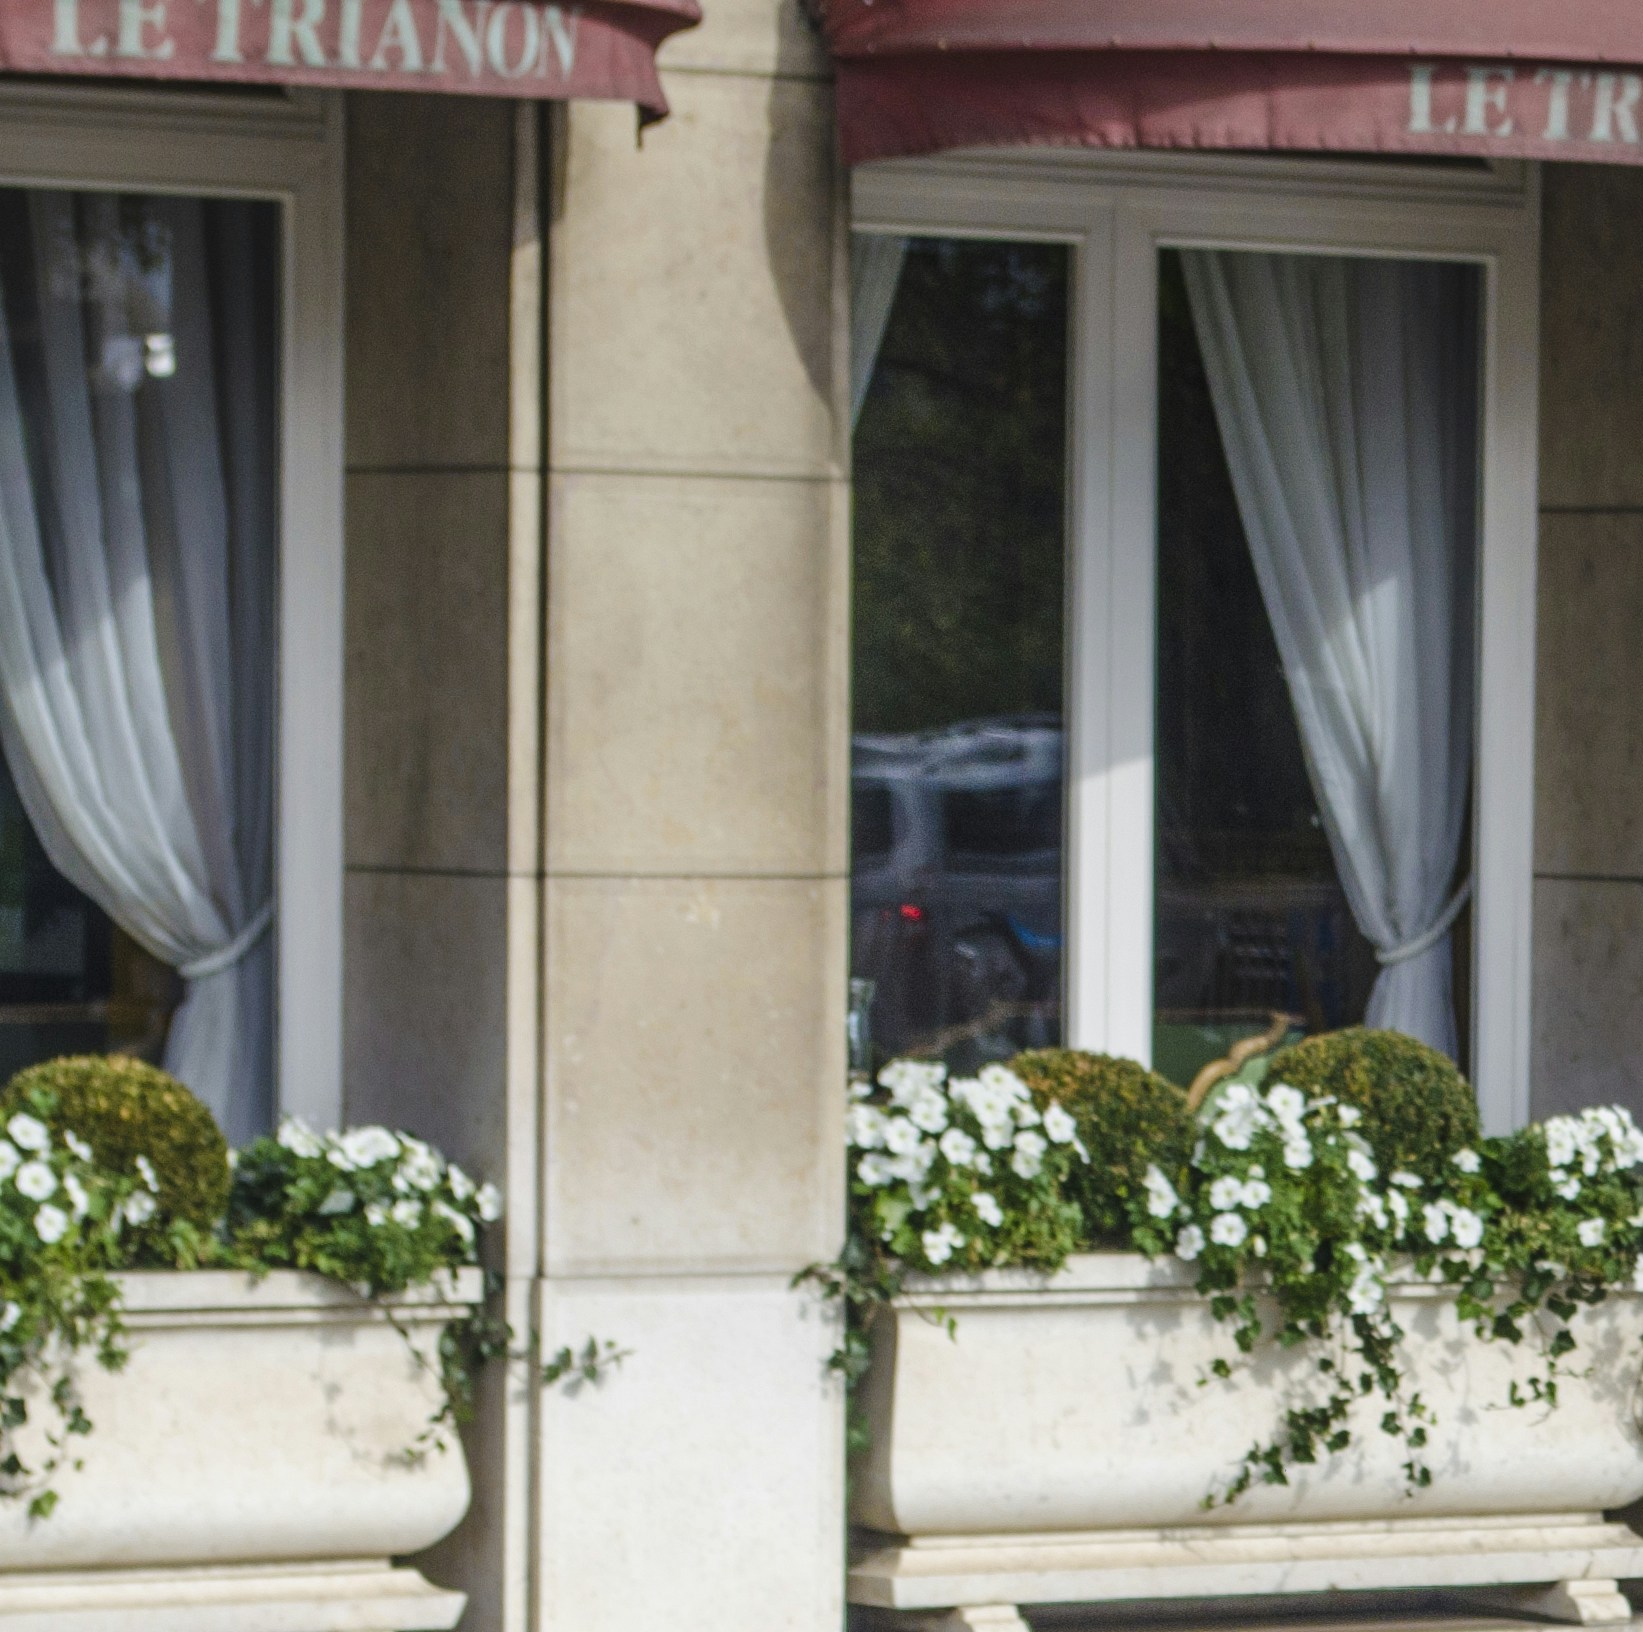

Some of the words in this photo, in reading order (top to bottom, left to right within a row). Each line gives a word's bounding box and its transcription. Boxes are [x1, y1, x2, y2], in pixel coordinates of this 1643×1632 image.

[50, 0, 176, 61] LE
[205, 0, 580, 81] TRIANON
[1406, 64, 1517, 138] LE
